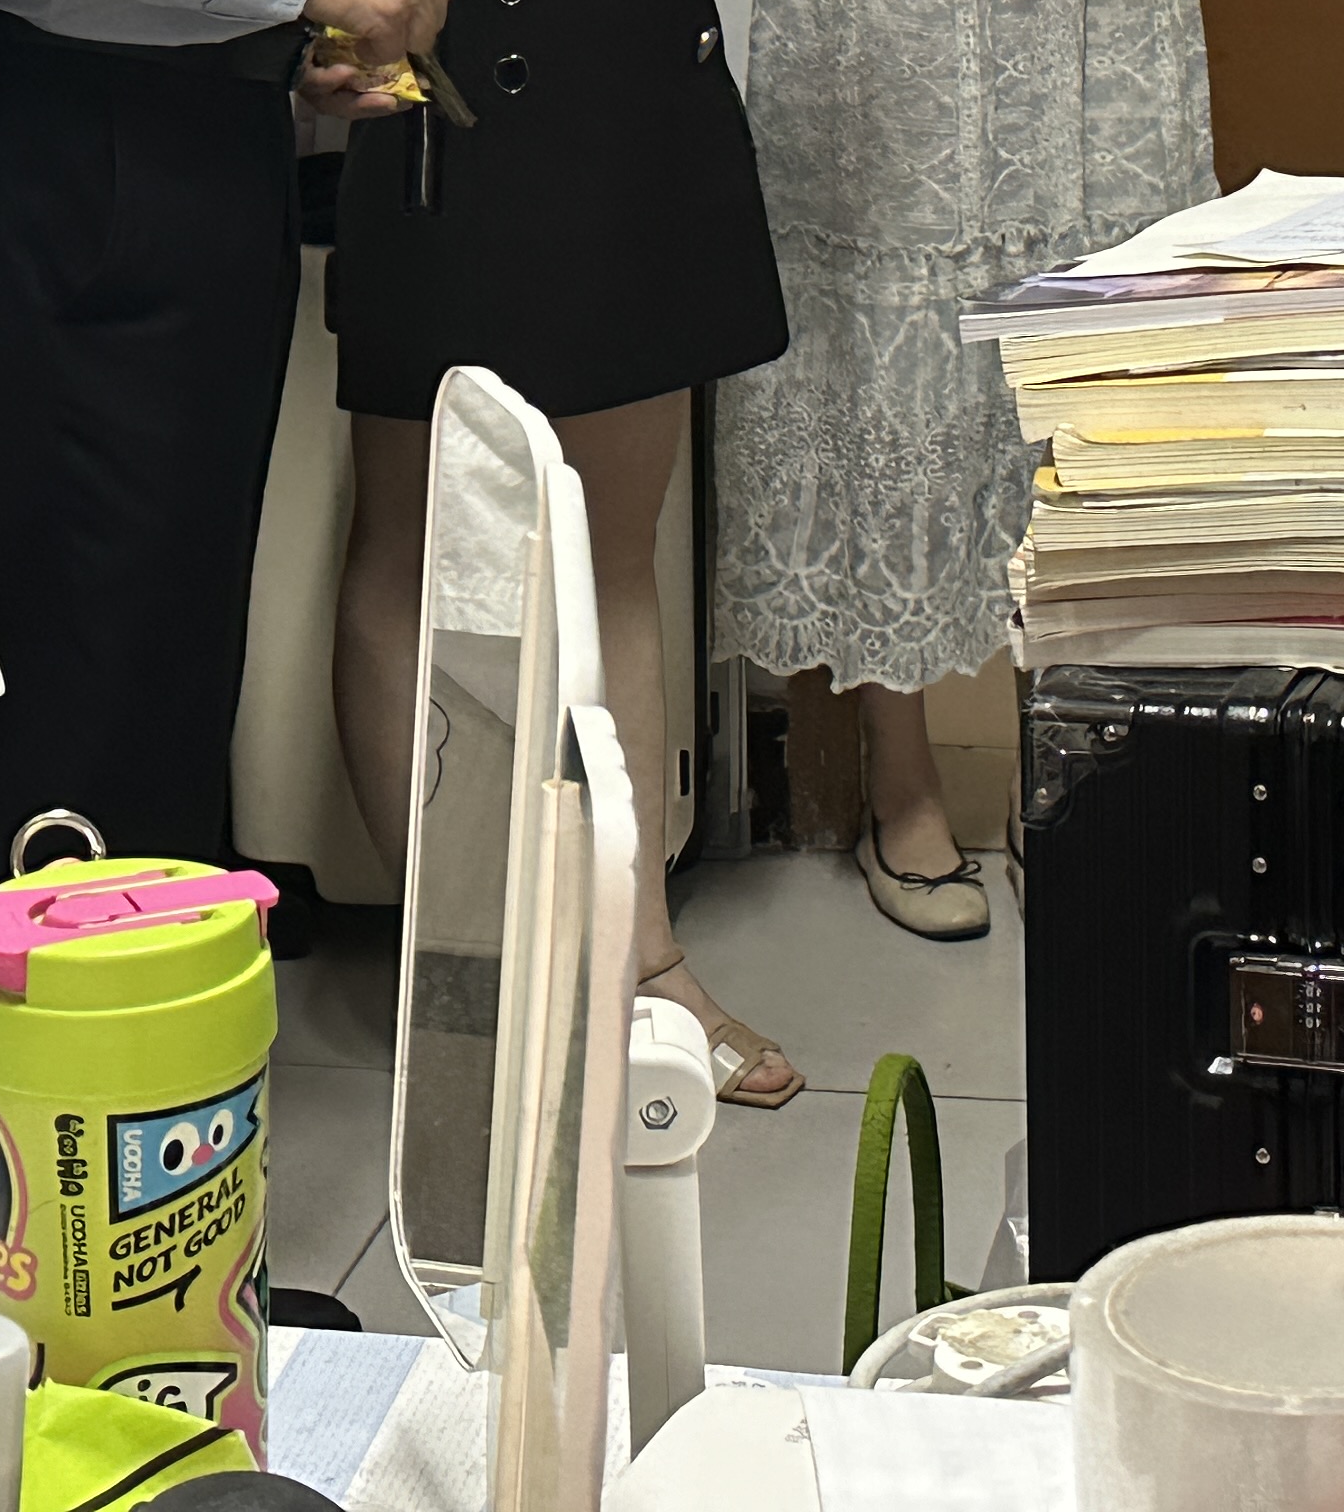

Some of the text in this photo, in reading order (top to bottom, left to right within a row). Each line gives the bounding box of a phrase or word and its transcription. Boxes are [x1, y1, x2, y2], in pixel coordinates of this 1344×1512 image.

[122, 1129, 143, 1202] UOOHA
[109, 1166, 244, 1260] GENERAL
[113, 1244, 177, 1293] NOT
[184, 1193, 246, 1258] GOOD
